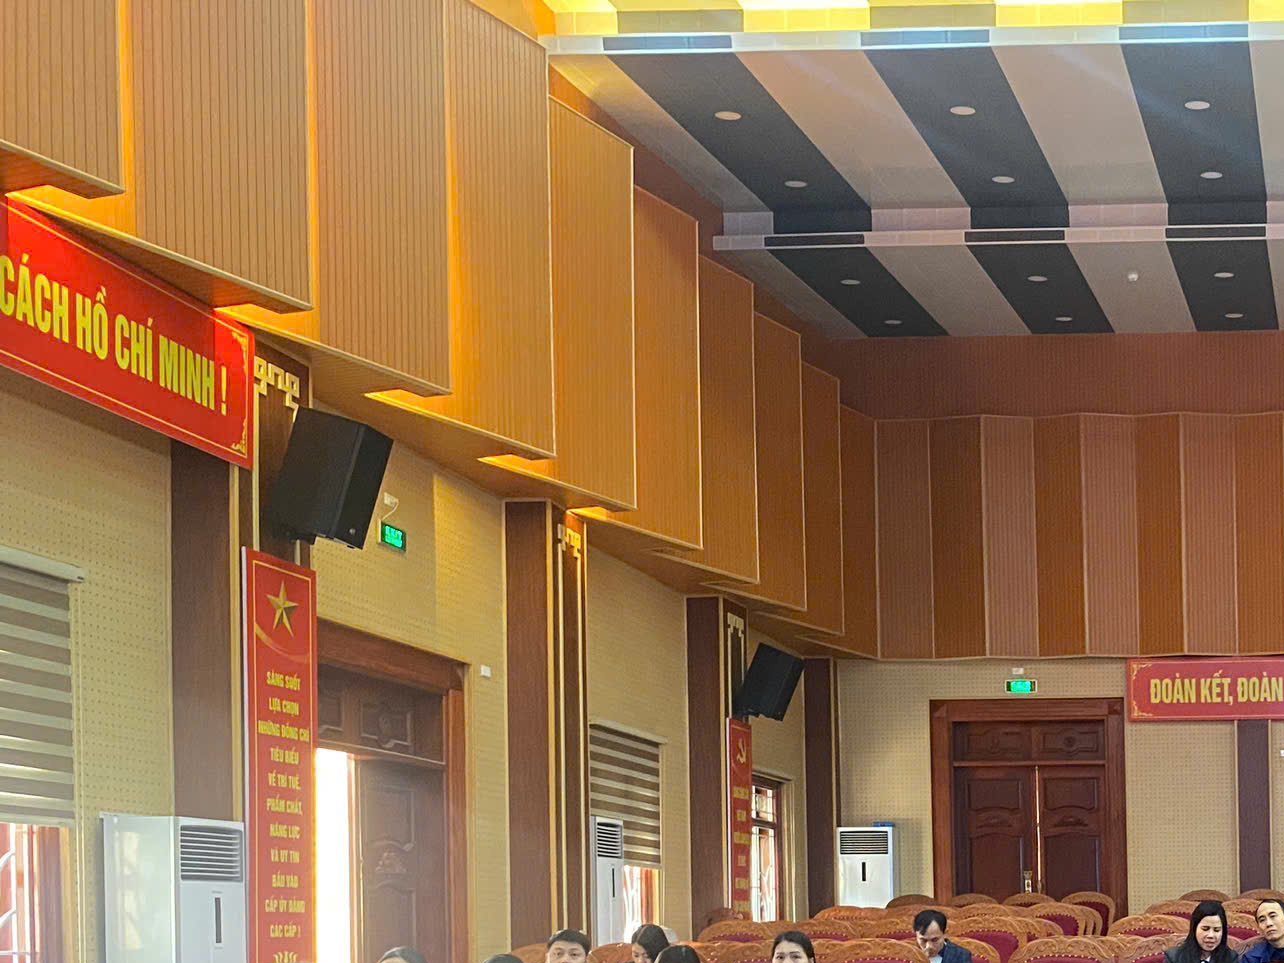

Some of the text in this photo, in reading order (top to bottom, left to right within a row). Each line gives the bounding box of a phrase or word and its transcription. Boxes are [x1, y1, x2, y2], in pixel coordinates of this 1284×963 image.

[0, 253, 227, 416] CÁCH HỒ CHÍ MINH !
[1150, 673, 1196, 704] ĐOÀN
[1200, 669, 1233, 706] KẾT,
[1237, 671, 1283, 703] ĐOÀN
